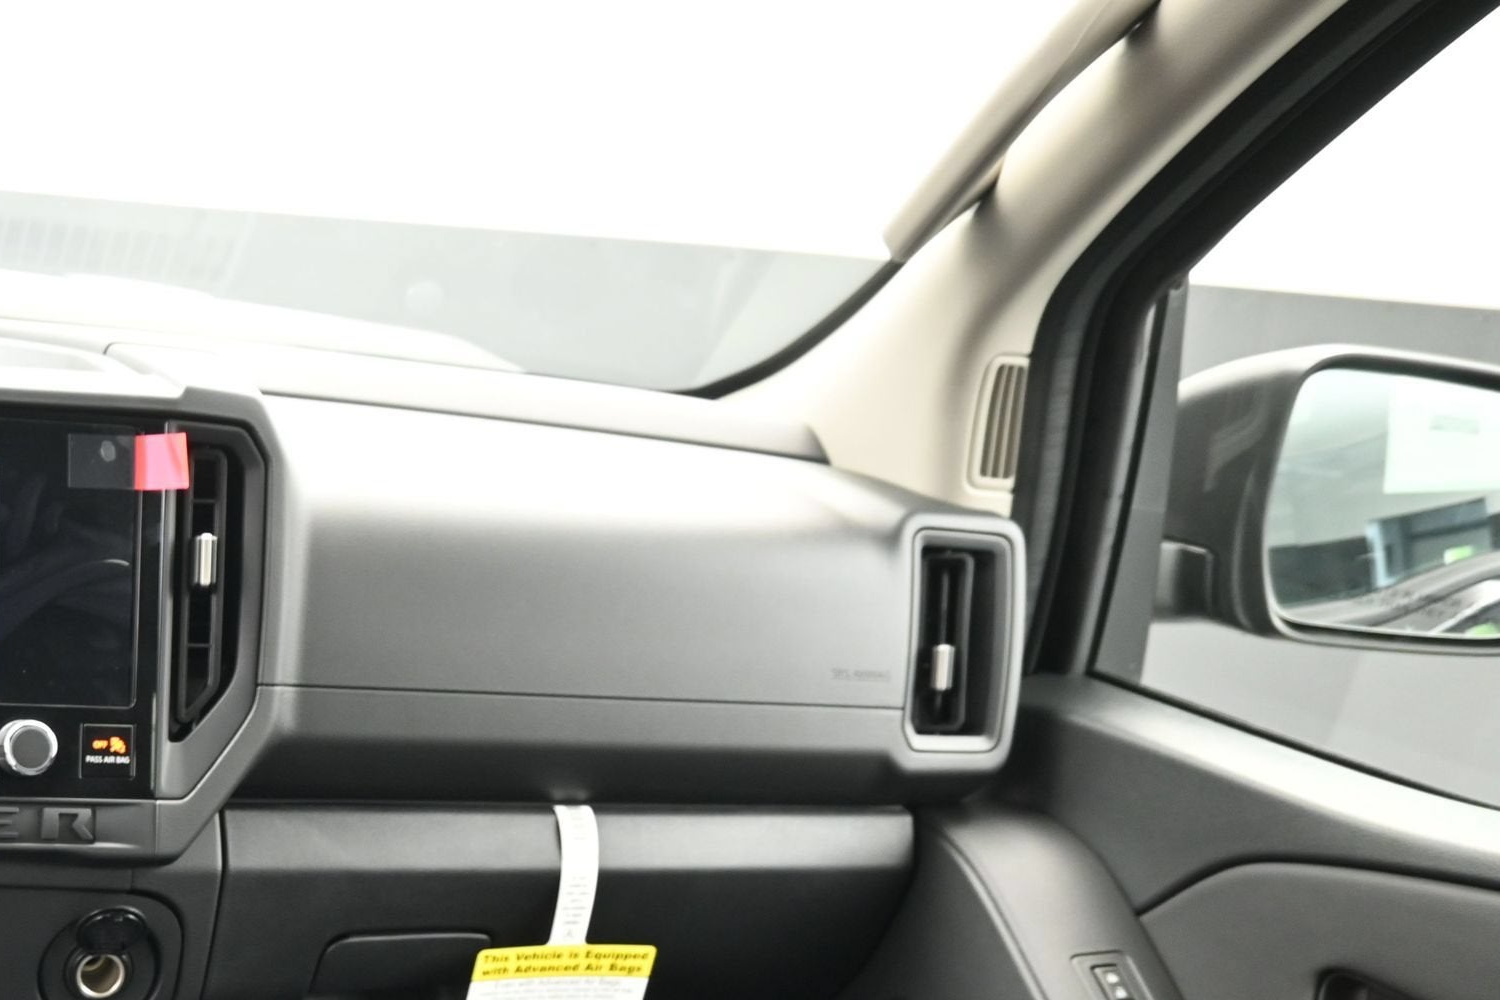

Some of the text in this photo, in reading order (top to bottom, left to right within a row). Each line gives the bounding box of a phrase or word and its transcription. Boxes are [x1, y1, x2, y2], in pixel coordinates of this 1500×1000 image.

[85, 755, 131, 765] PASS AIR BAG
[484, 950, 649, 964] This Vehicle is Equipped
[481, 962, 643, 977] with Advanced Air Bags
